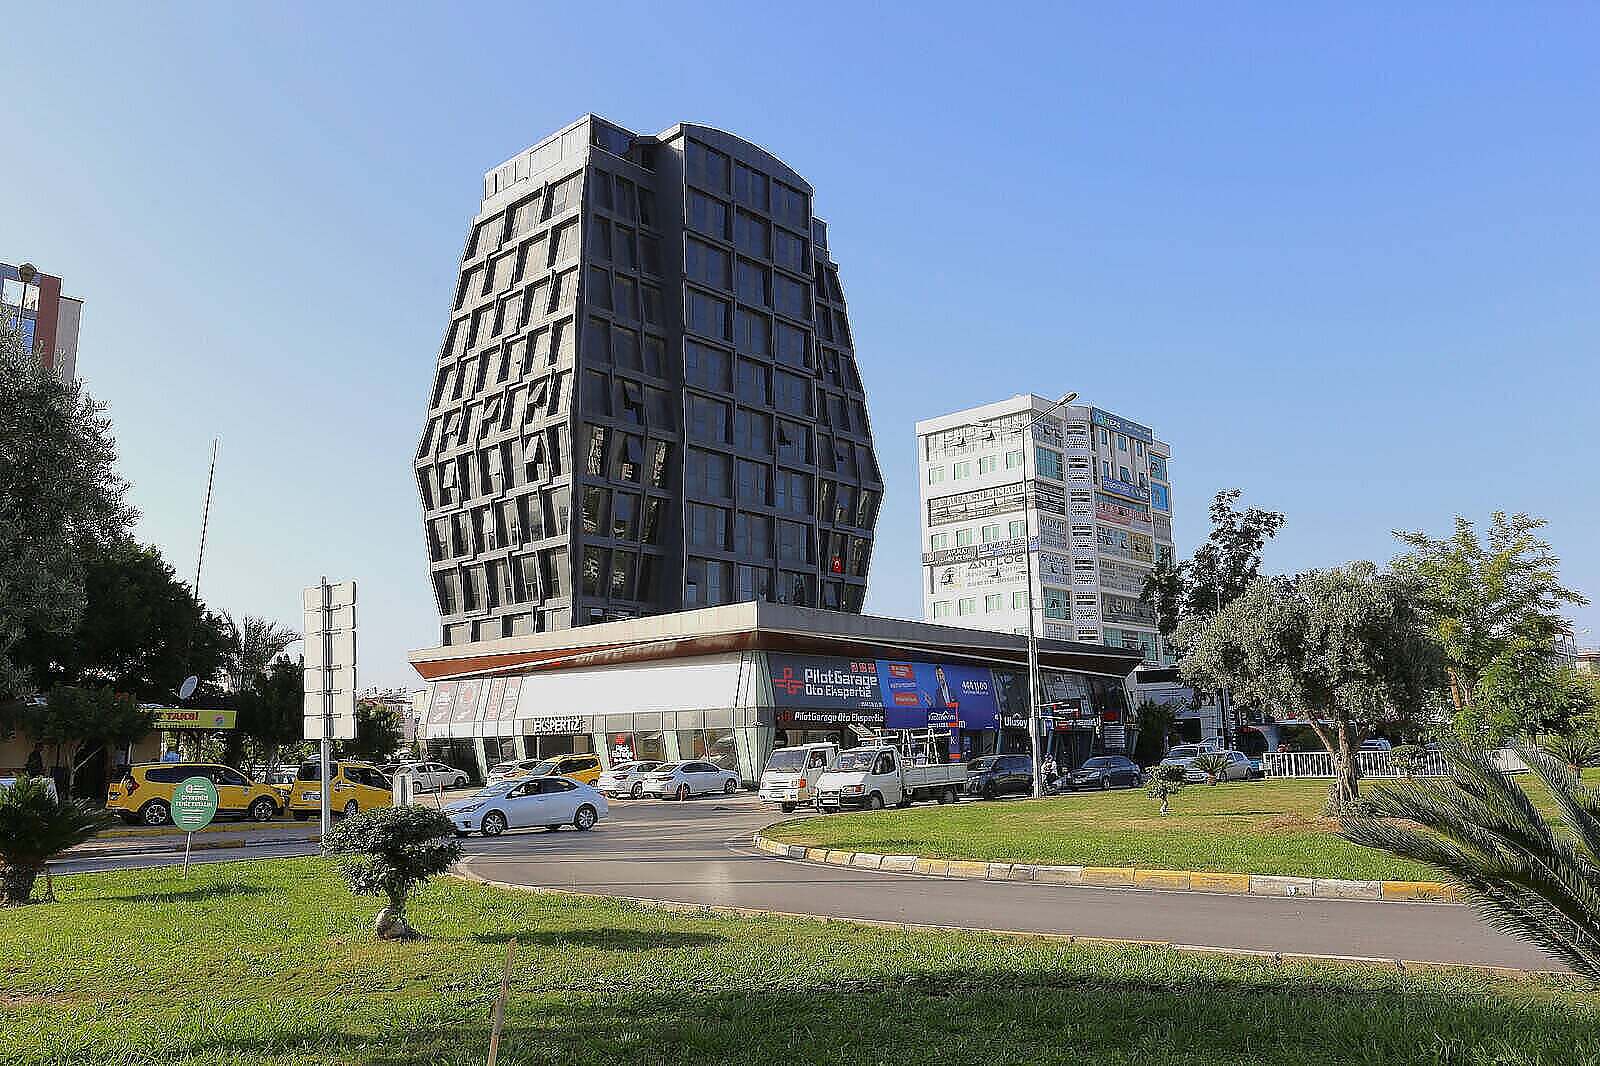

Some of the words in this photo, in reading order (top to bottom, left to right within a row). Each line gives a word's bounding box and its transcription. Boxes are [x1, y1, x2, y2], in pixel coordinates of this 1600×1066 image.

[805, 669, 878, 689] PilotGarage
[805, 684, 823, 696] Oto
[826, 686, 872, 700] Ekspertiz
[838, 713, 851, 722] Oto
[1004, 716, 1028, 729] Ulusoy
